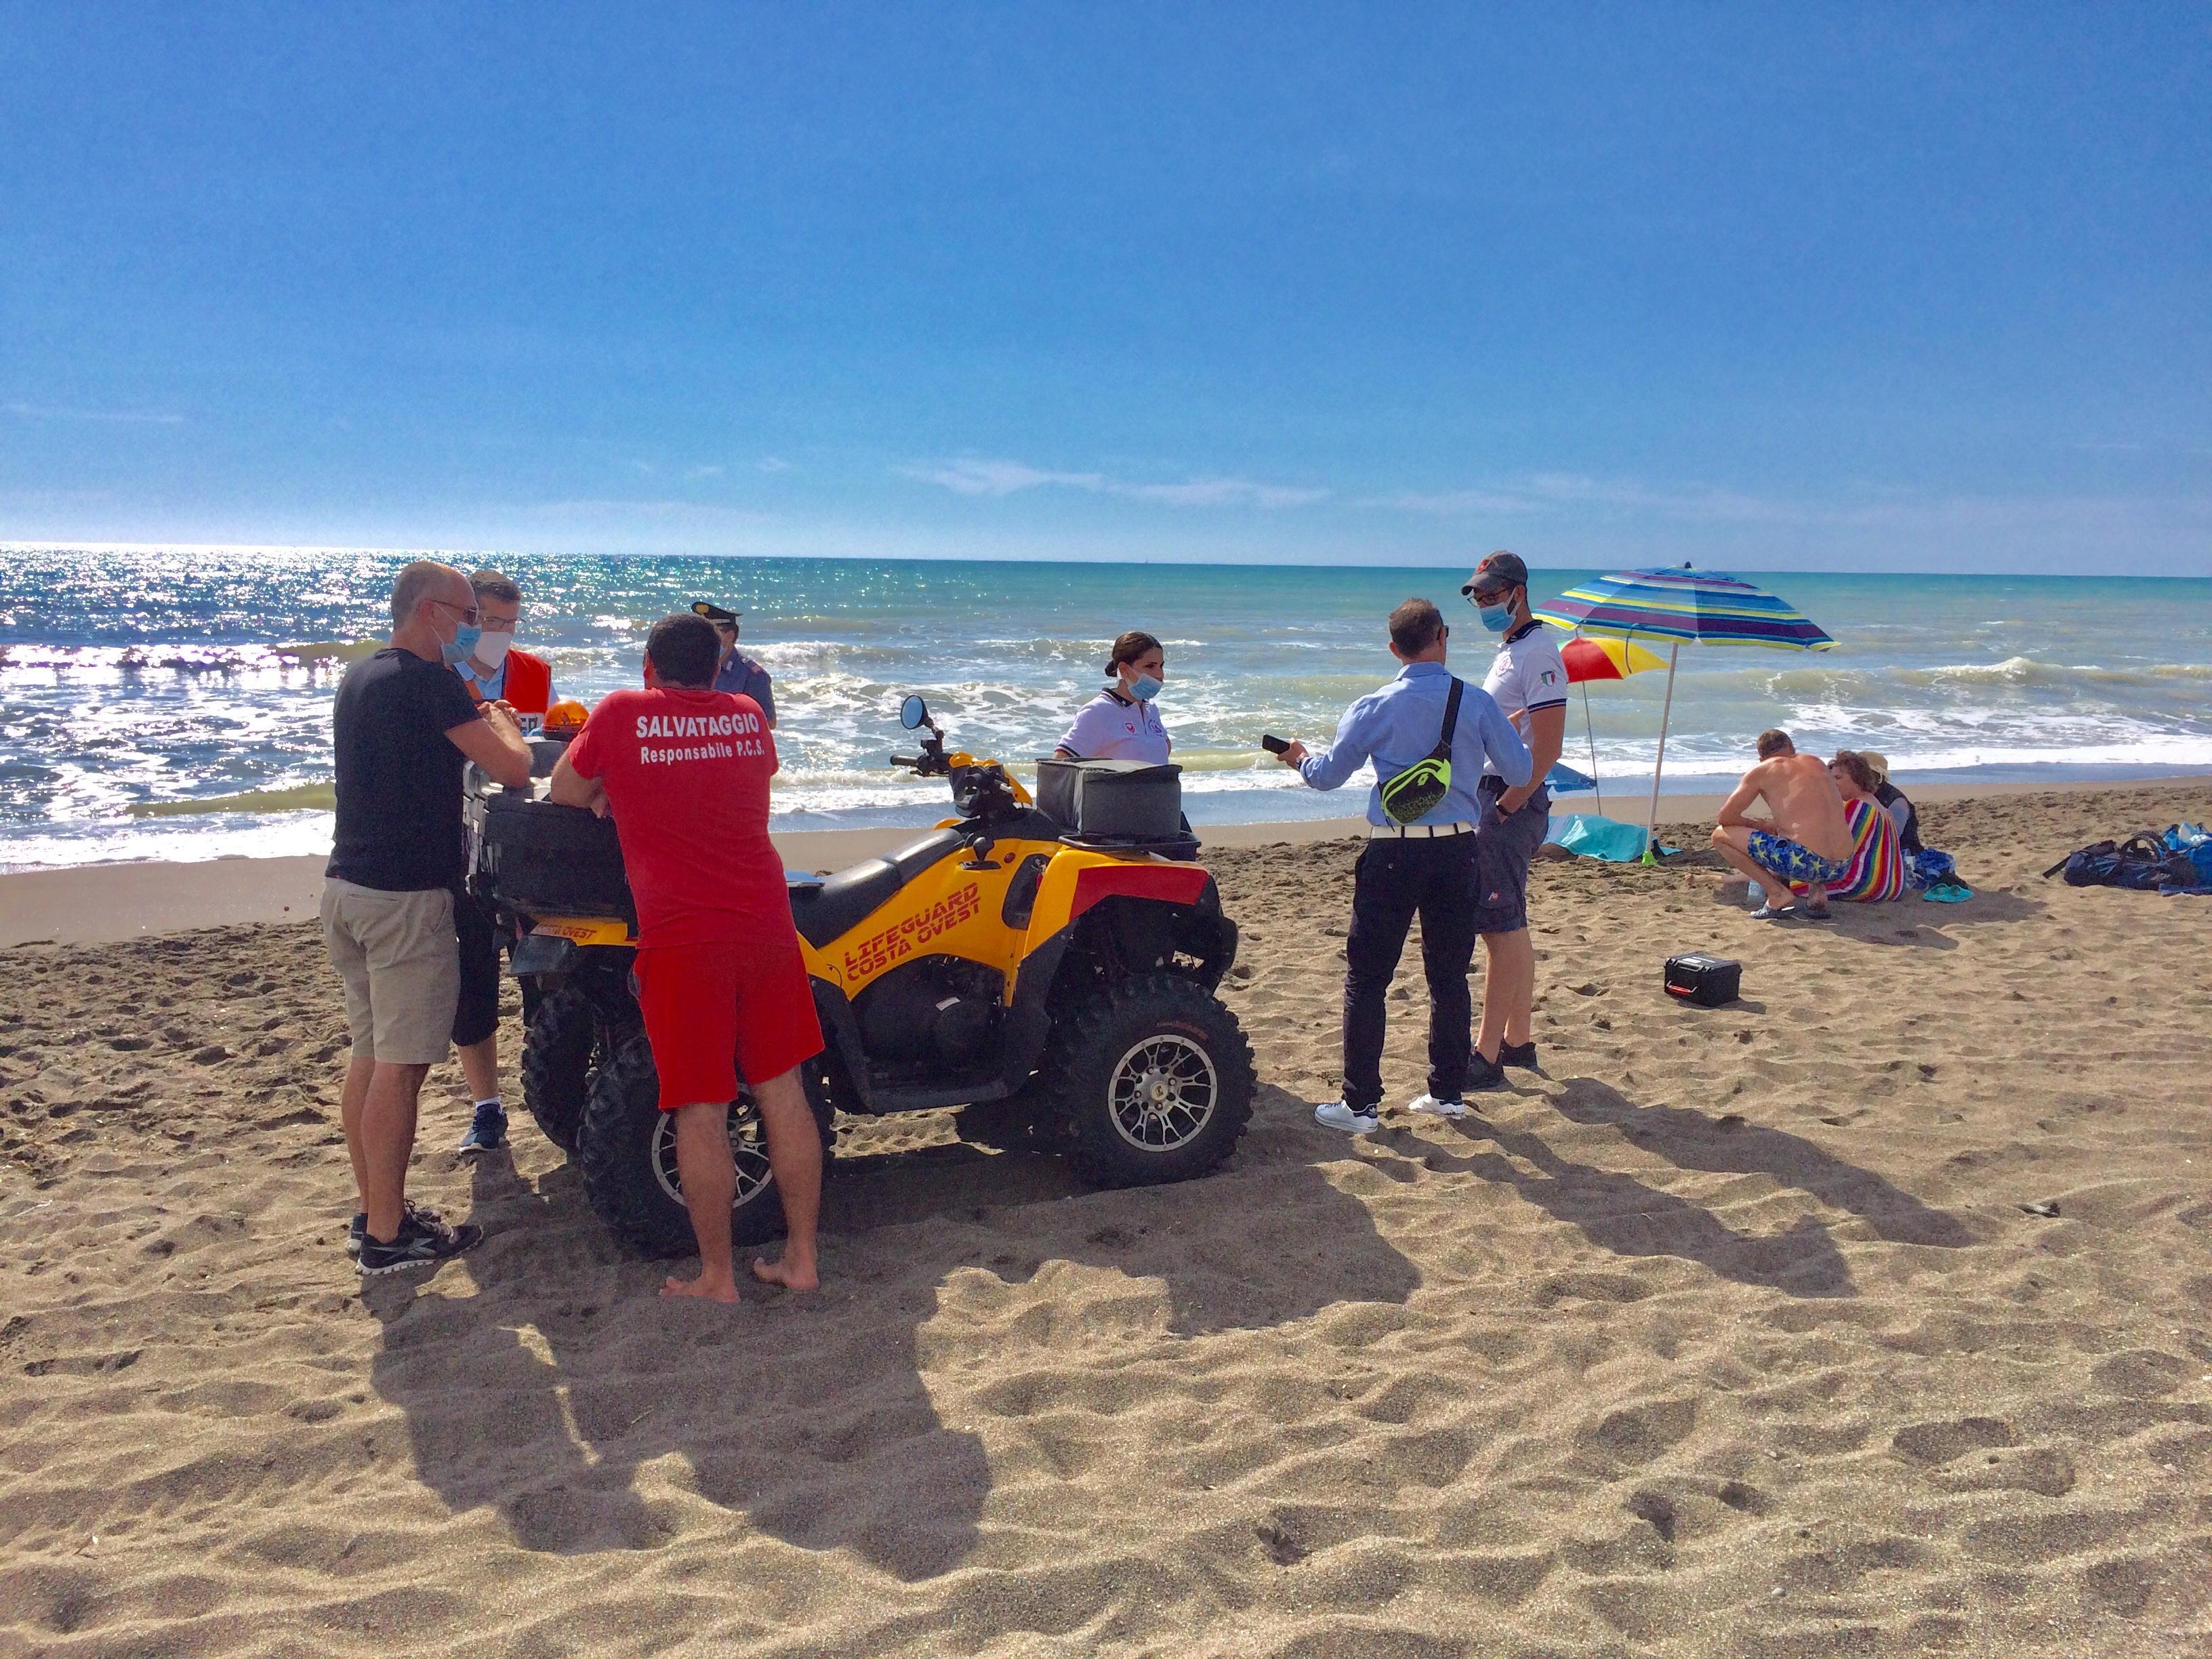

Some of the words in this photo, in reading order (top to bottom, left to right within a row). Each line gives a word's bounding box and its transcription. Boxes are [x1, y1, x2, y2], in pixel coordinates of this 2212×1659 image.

[636, 712, 760, 738] SALVATAGGIO
[640, 742, 733, 766] Responsabile
[736, 739, 765, 757] P.C.S.
[844, 882, 978, 968] LIFEGUARD
[847, 939, 912, 981] COSTA
[917, 897, 981, 943] OVEST
